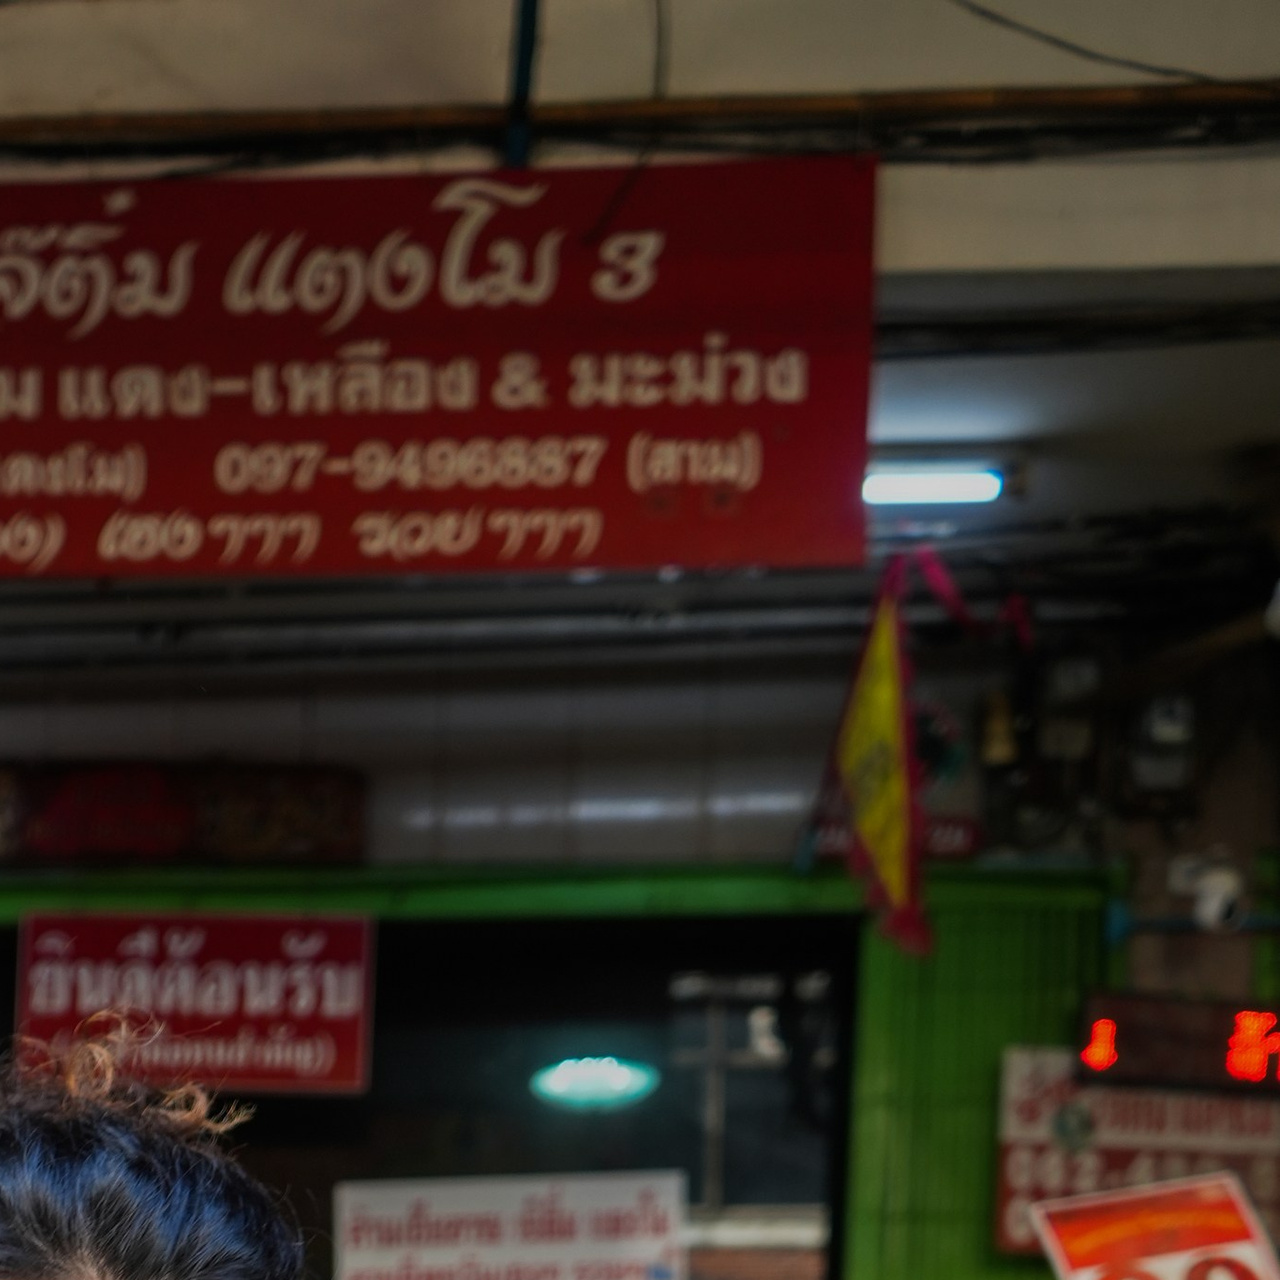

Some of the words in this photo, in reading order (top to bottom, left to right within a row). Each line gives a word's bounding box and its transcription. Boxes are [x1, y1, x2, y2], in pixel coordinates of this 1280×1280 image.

[220, 176, 569, 337] แตงโม
[588, 228, 668, 305] 3
[490, 351, 551, 412] &
[568, 333, 811, 408] มะม่วง
[27, 925, 365, 1019] ยินดีต้อนรับ
